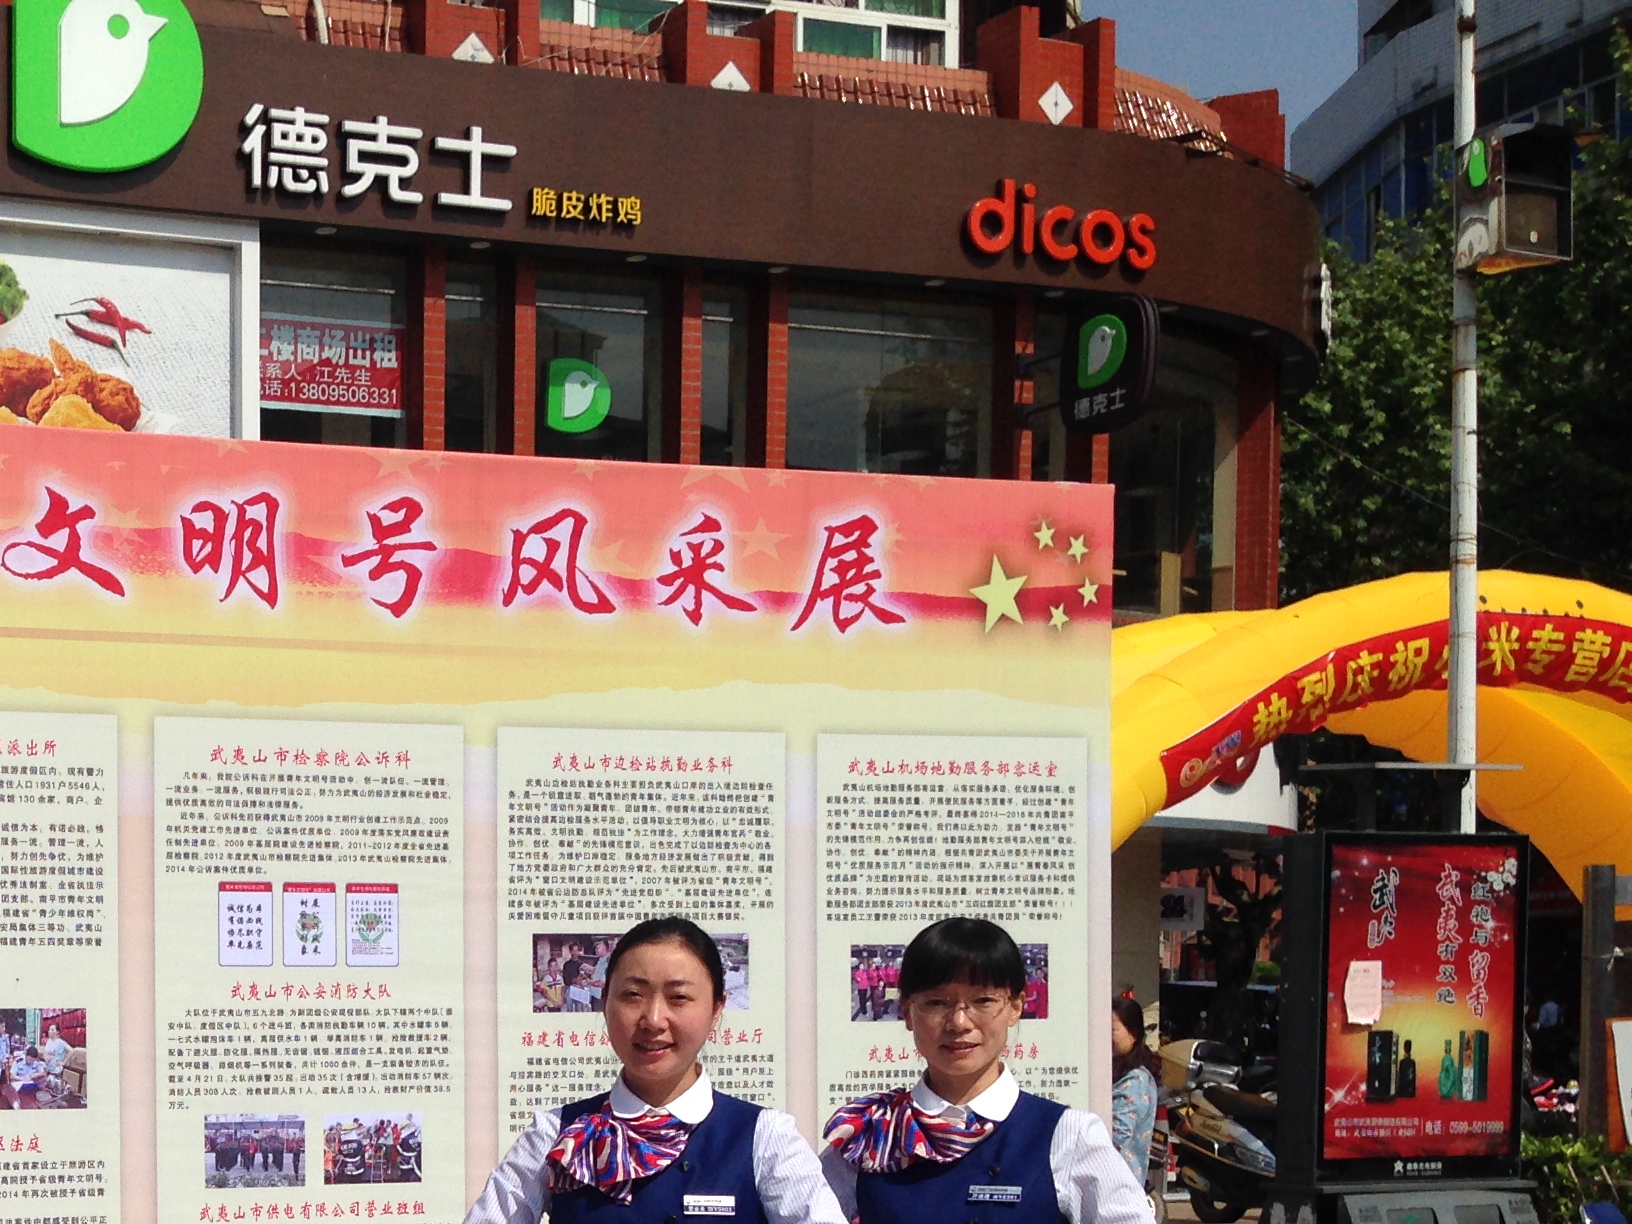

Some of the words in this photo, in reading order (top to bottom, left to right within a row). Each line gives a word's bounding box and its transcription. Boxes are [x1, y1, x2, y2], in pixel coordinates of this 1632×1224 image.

[242, 102, 518, 213] 德克士
[531, 186, 644, 227] 脆皮炸鸡
[969, 178, 1159, 273] dicos
[1073, 387, 1126, 420] 德克士
[209, 744, 411, 769] 武夷山市检察院公诉科
[552, 752, 735, 775] 武夷山市边检站执勤业务科
[230, 981, 392, 1001] 武夷山市公安消防大队
[199, 1199, 426, 1222] 武夷山市供电有限公司营业班组
